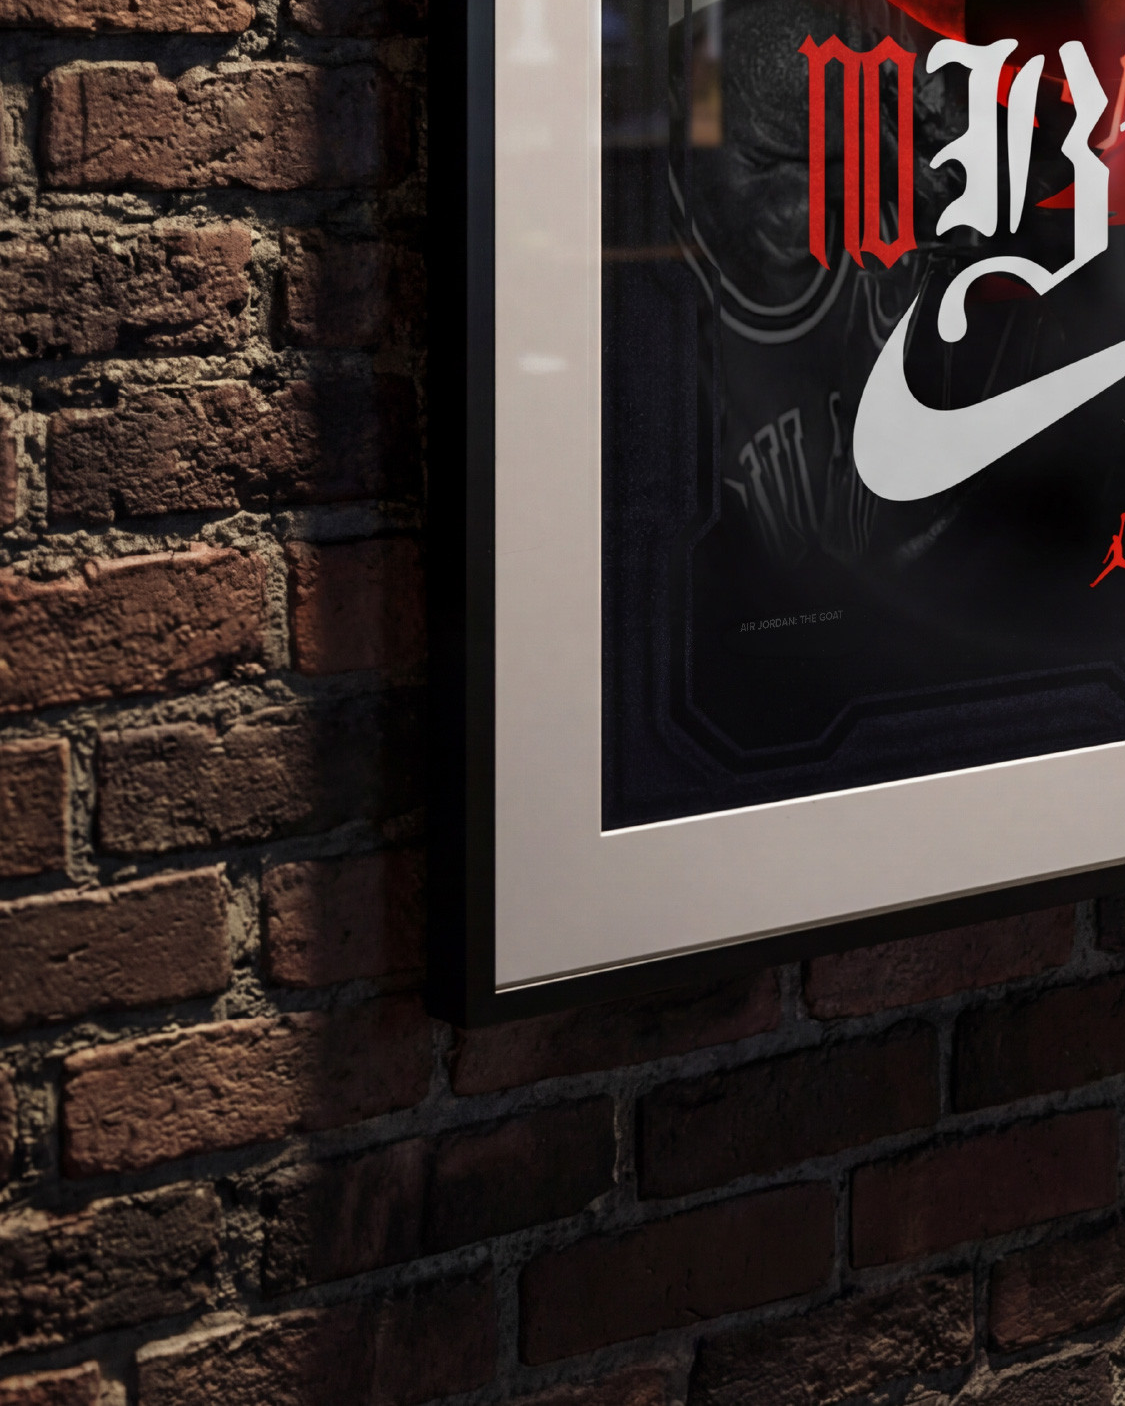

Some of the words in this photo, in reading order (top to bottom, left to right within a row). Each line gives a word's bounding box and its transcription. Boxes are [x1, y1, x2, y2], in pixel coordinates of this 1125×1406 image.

[740, 622, 756, 632] AIR
[758, 617, 798, 630] JORDAN:
[800, 613, 817, 624] THE
[819, 610, 844, 622] GOAT
